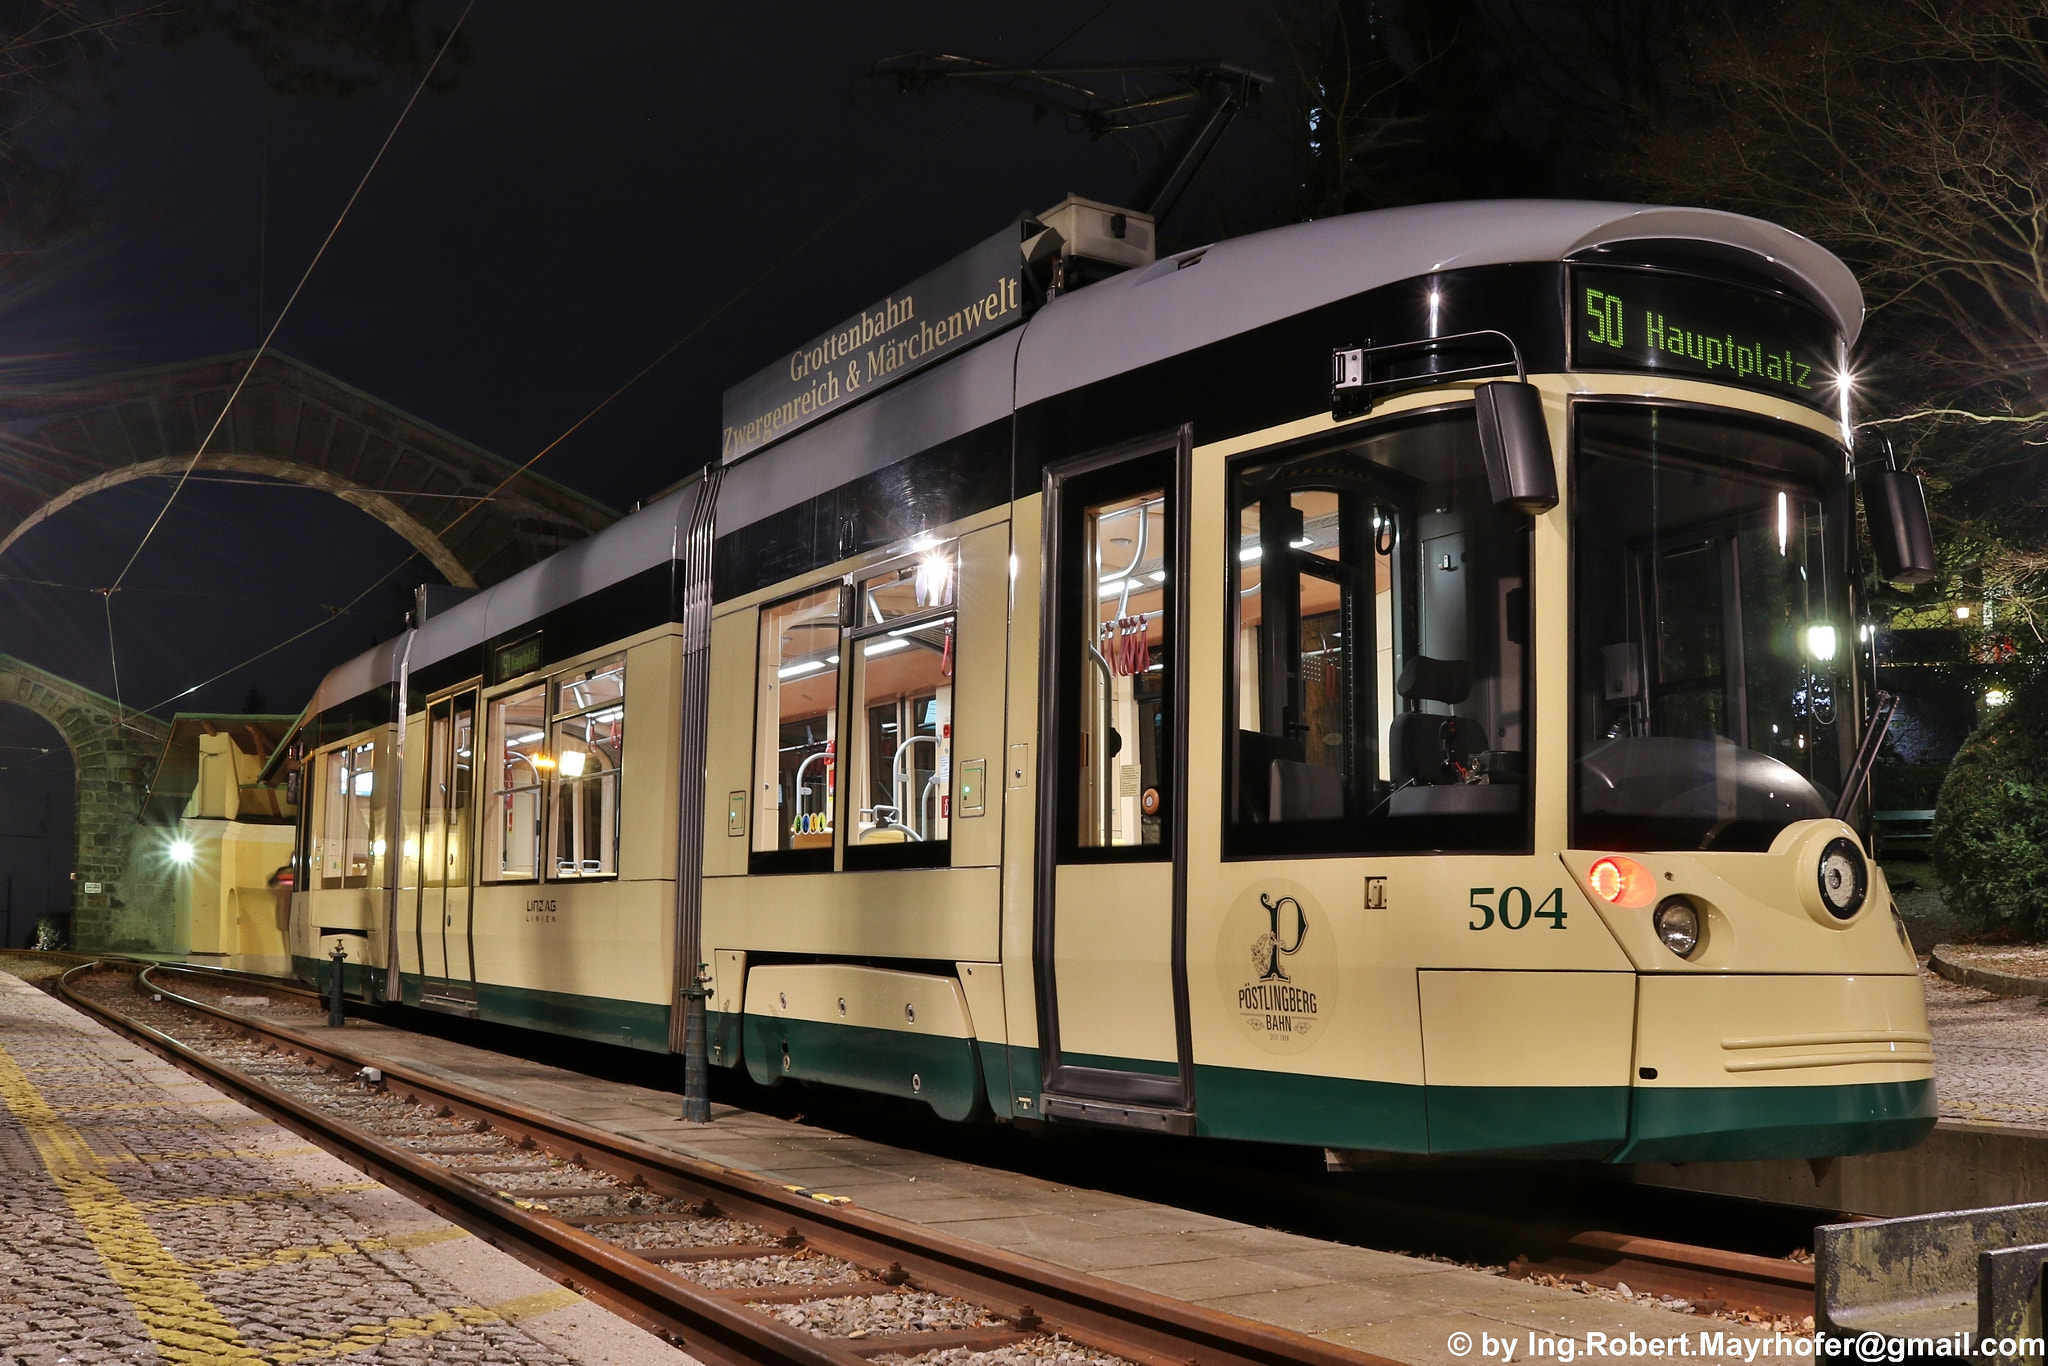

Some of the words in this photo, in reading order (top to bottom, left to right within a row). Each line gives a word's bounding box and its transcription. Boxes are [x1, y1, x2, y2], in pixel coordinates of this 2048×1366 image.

[723, 371, 840, 456] Zwergenreich
[845, 359, 861, 393] &
[866, 276, 1018, 383] Märchenwelt
[790, 295, 914, 382] Grottenbahn
[1586, 287, 1624, 349] 50
[1646, 310, 1812, 390] Hauptplatz
[1469, 886, 1568, 930] 504
[1238, 983, 1317, 1013] PÖSTLINGBERG
[1266, 1014, 1292, 1032] BAHN
